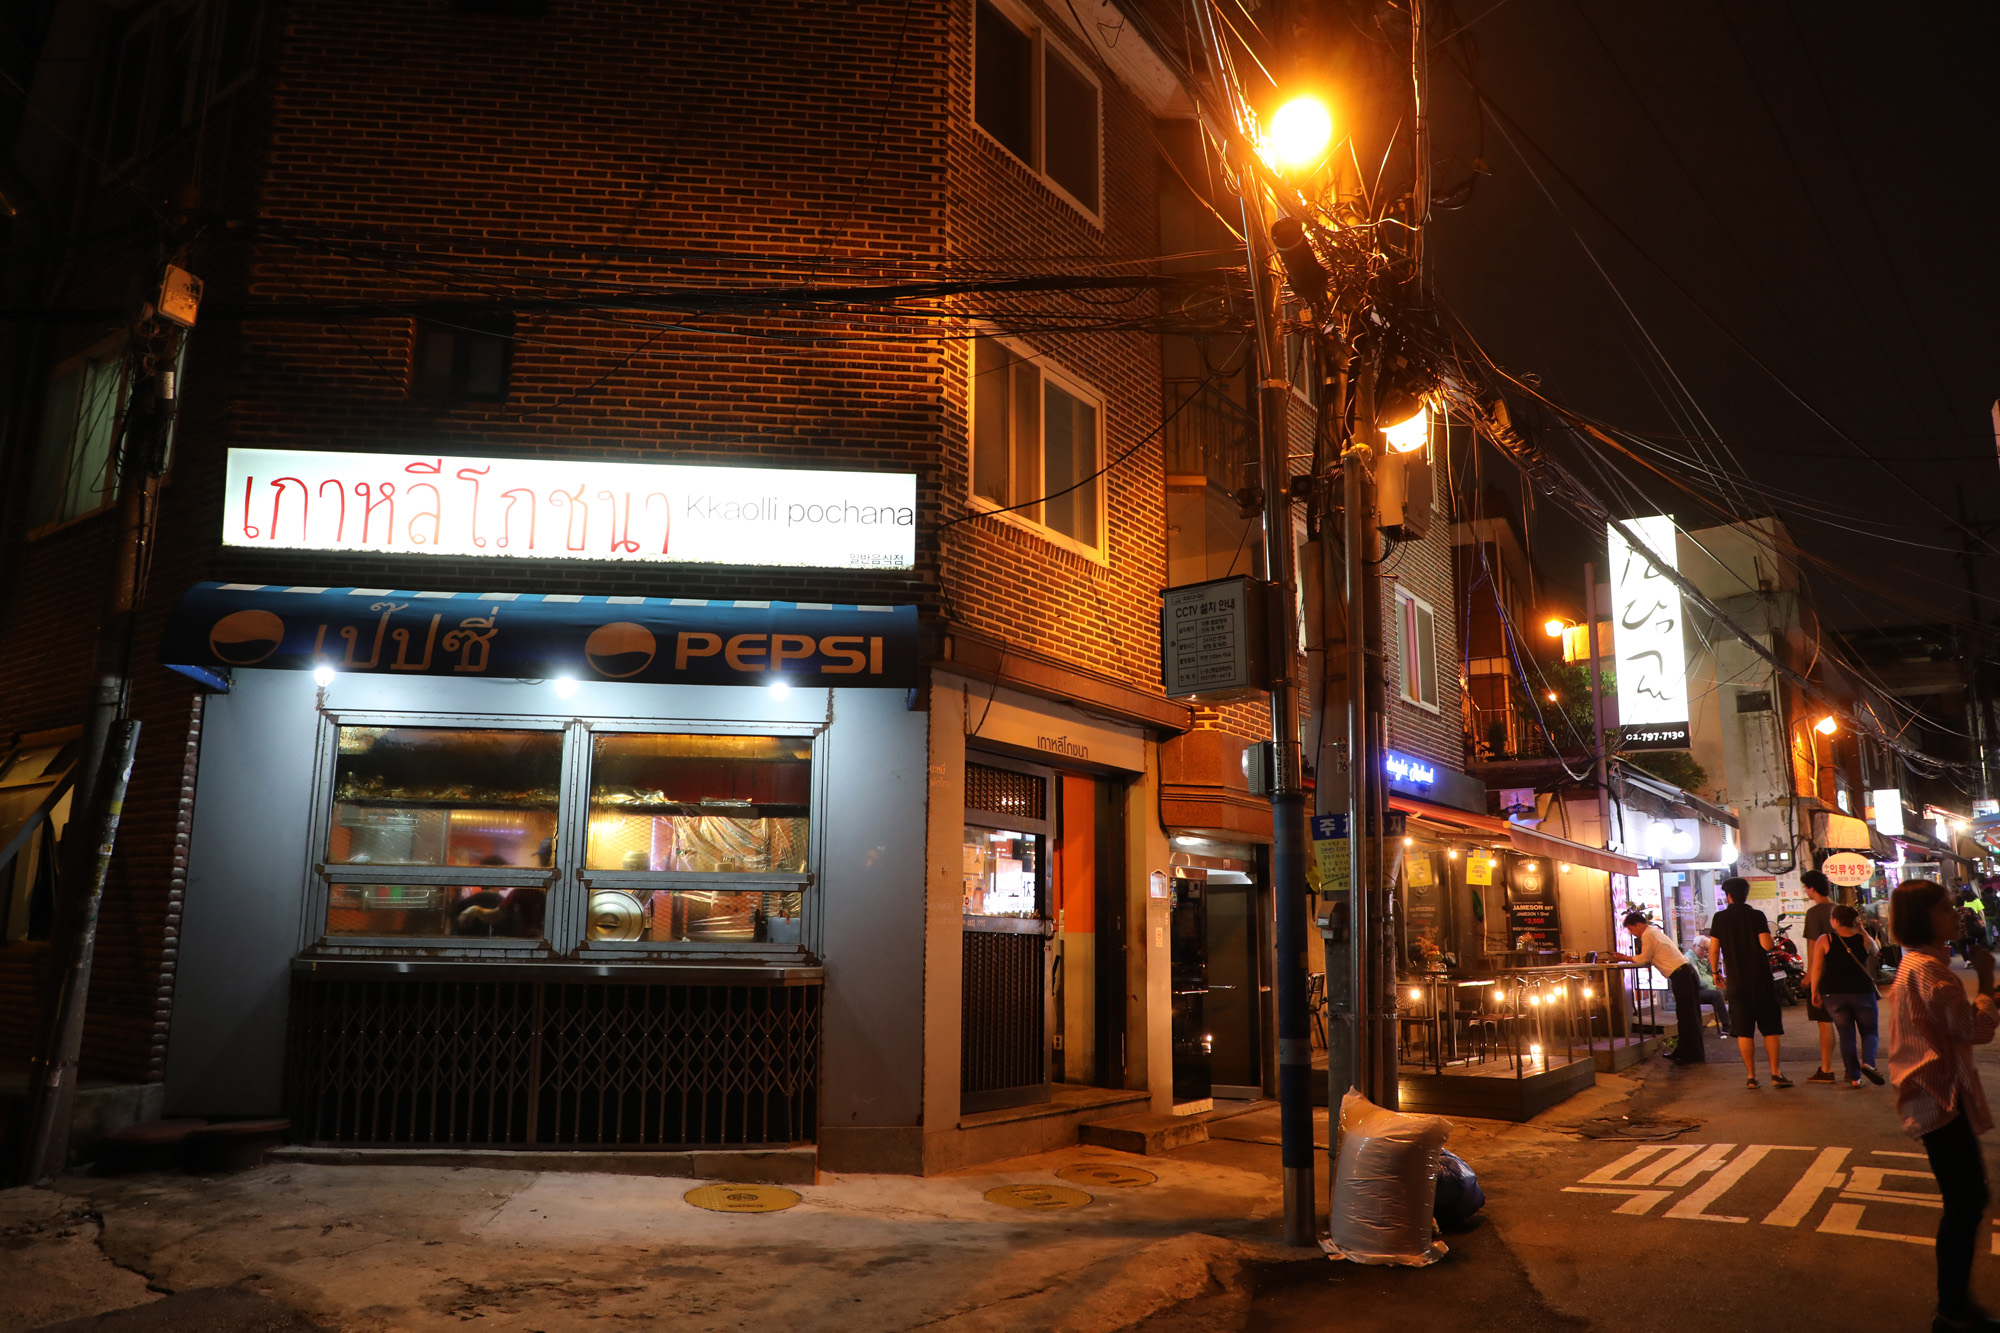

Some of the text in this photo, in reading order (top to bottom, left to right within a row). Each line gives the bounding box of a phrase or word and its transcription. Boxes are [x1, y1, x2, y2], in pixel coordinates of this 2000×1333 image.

[243, 459, 670, 555] เกาหลีโภชนา
[686, 495, 914, 528] Kkaolli pochana
[849, 553, 904, 565] 일반음식점
[1175, 598, 1235, 618] CCTV 설치 안내
[675, 632, 884, 676] PEPSI
[1625, 730, 1685, 742] 02.797.7130
[1829, 864, 1865, 876] 의류성형
